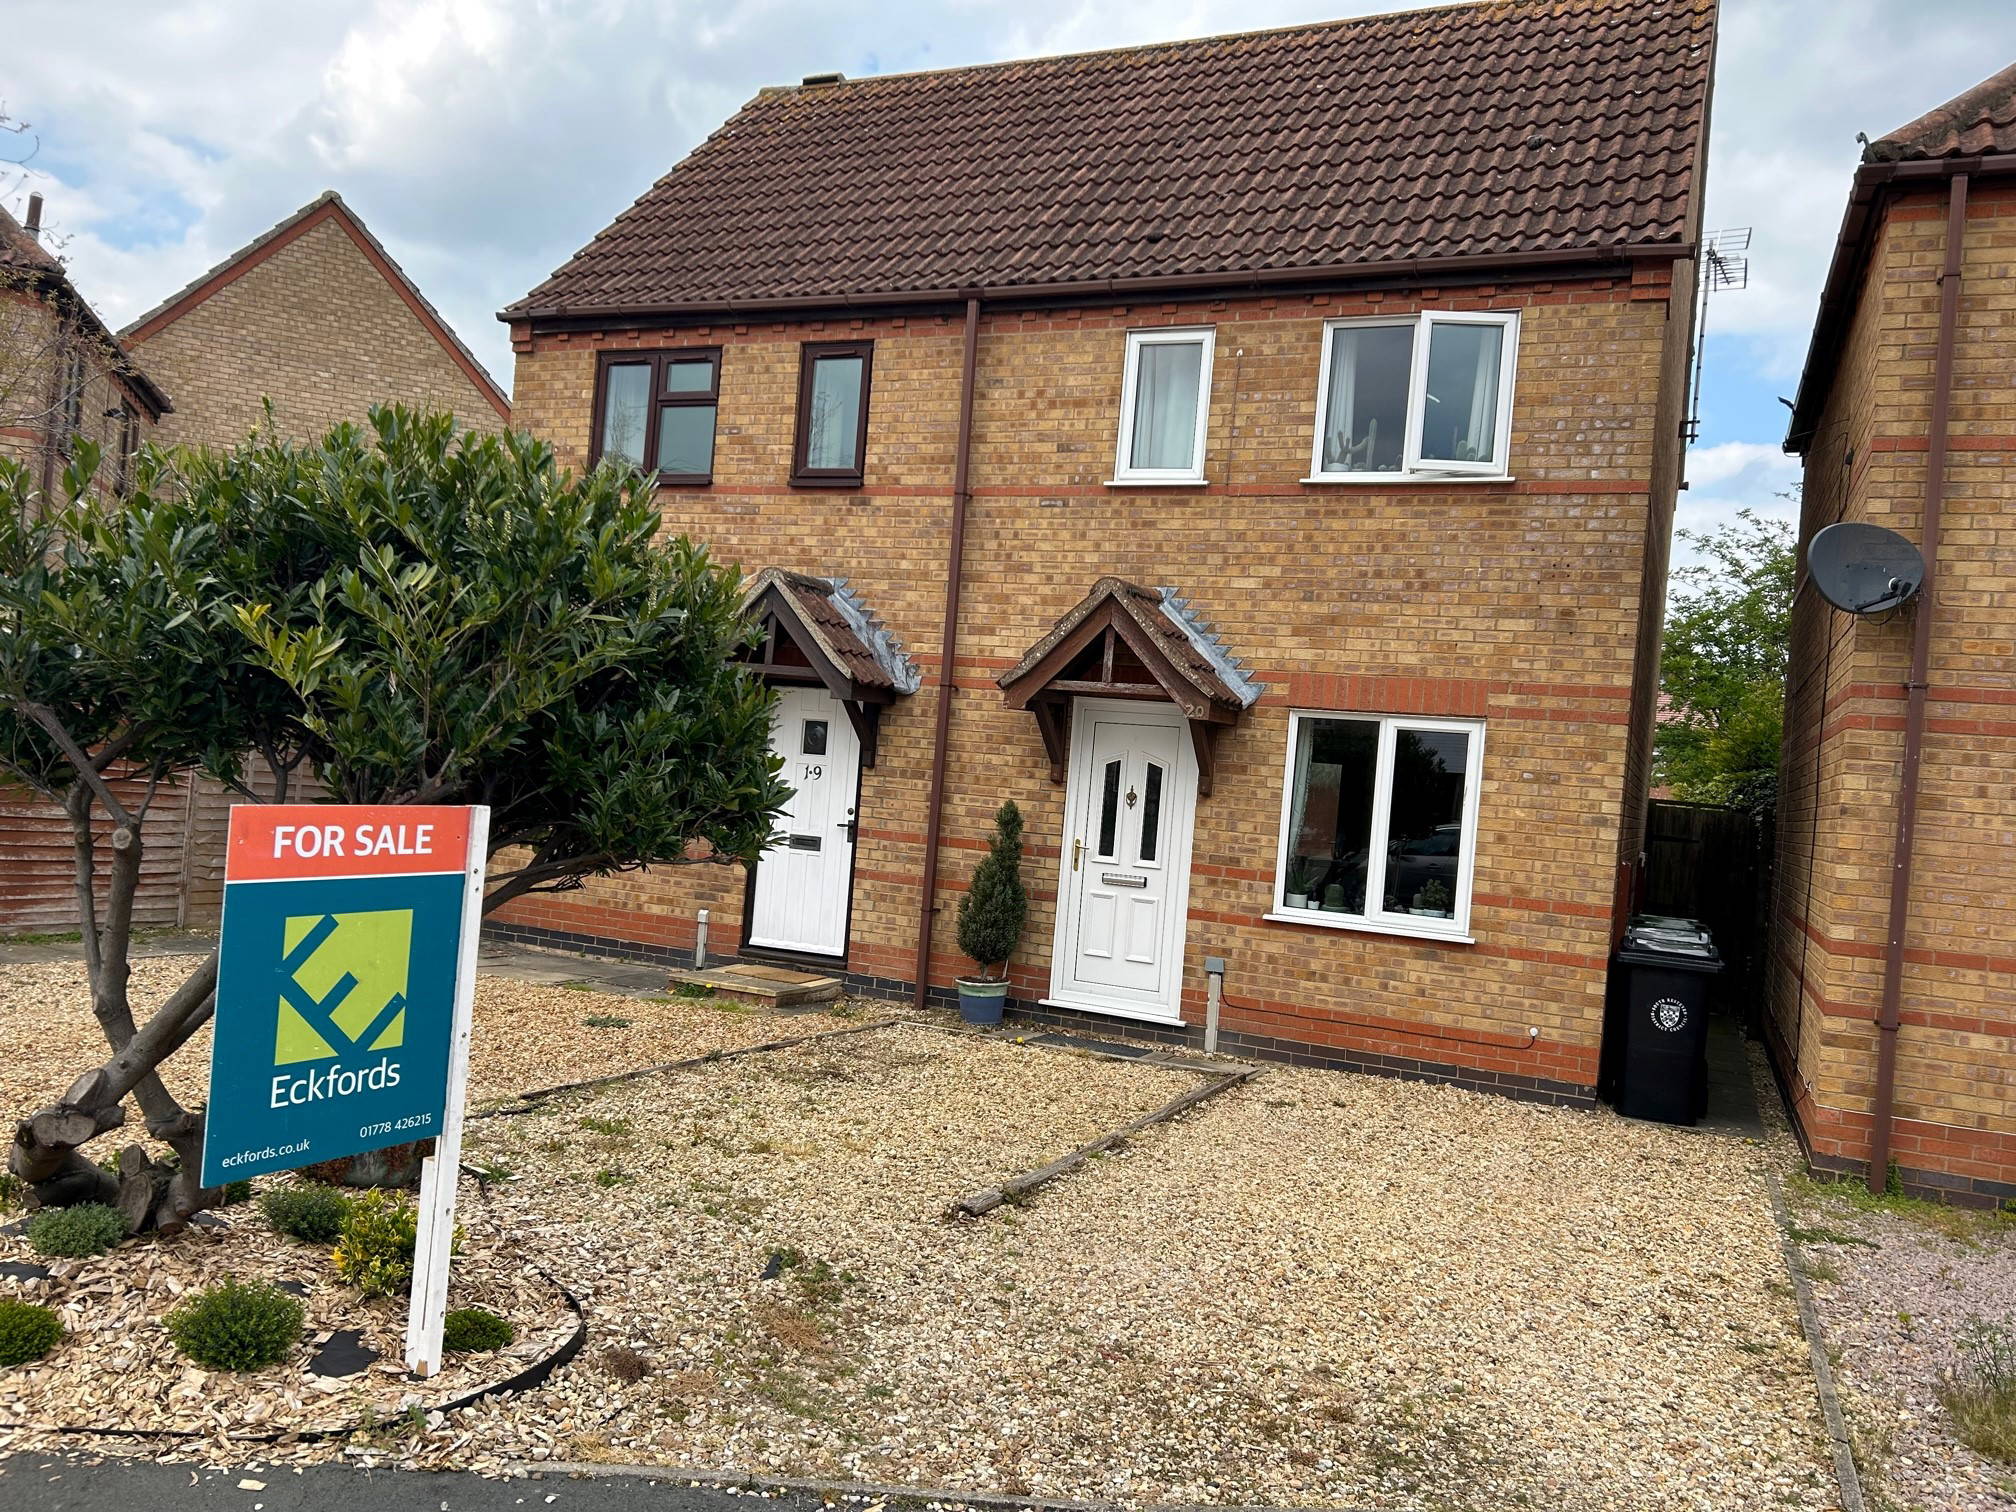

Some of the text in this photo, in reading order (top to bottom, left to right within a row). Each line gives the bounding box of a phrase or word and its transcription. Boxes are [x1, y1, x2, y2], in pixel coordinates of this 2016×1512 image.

[1184, 703, 1204, 719] 20
[272, 824, 434, 858] FOR SALE
[270, 1058, 401, 1109] Eckfords
[359, 1112, 432, 1138] 01778 426215
[222, 1139, 311, 1169] eckfords.co.uk
